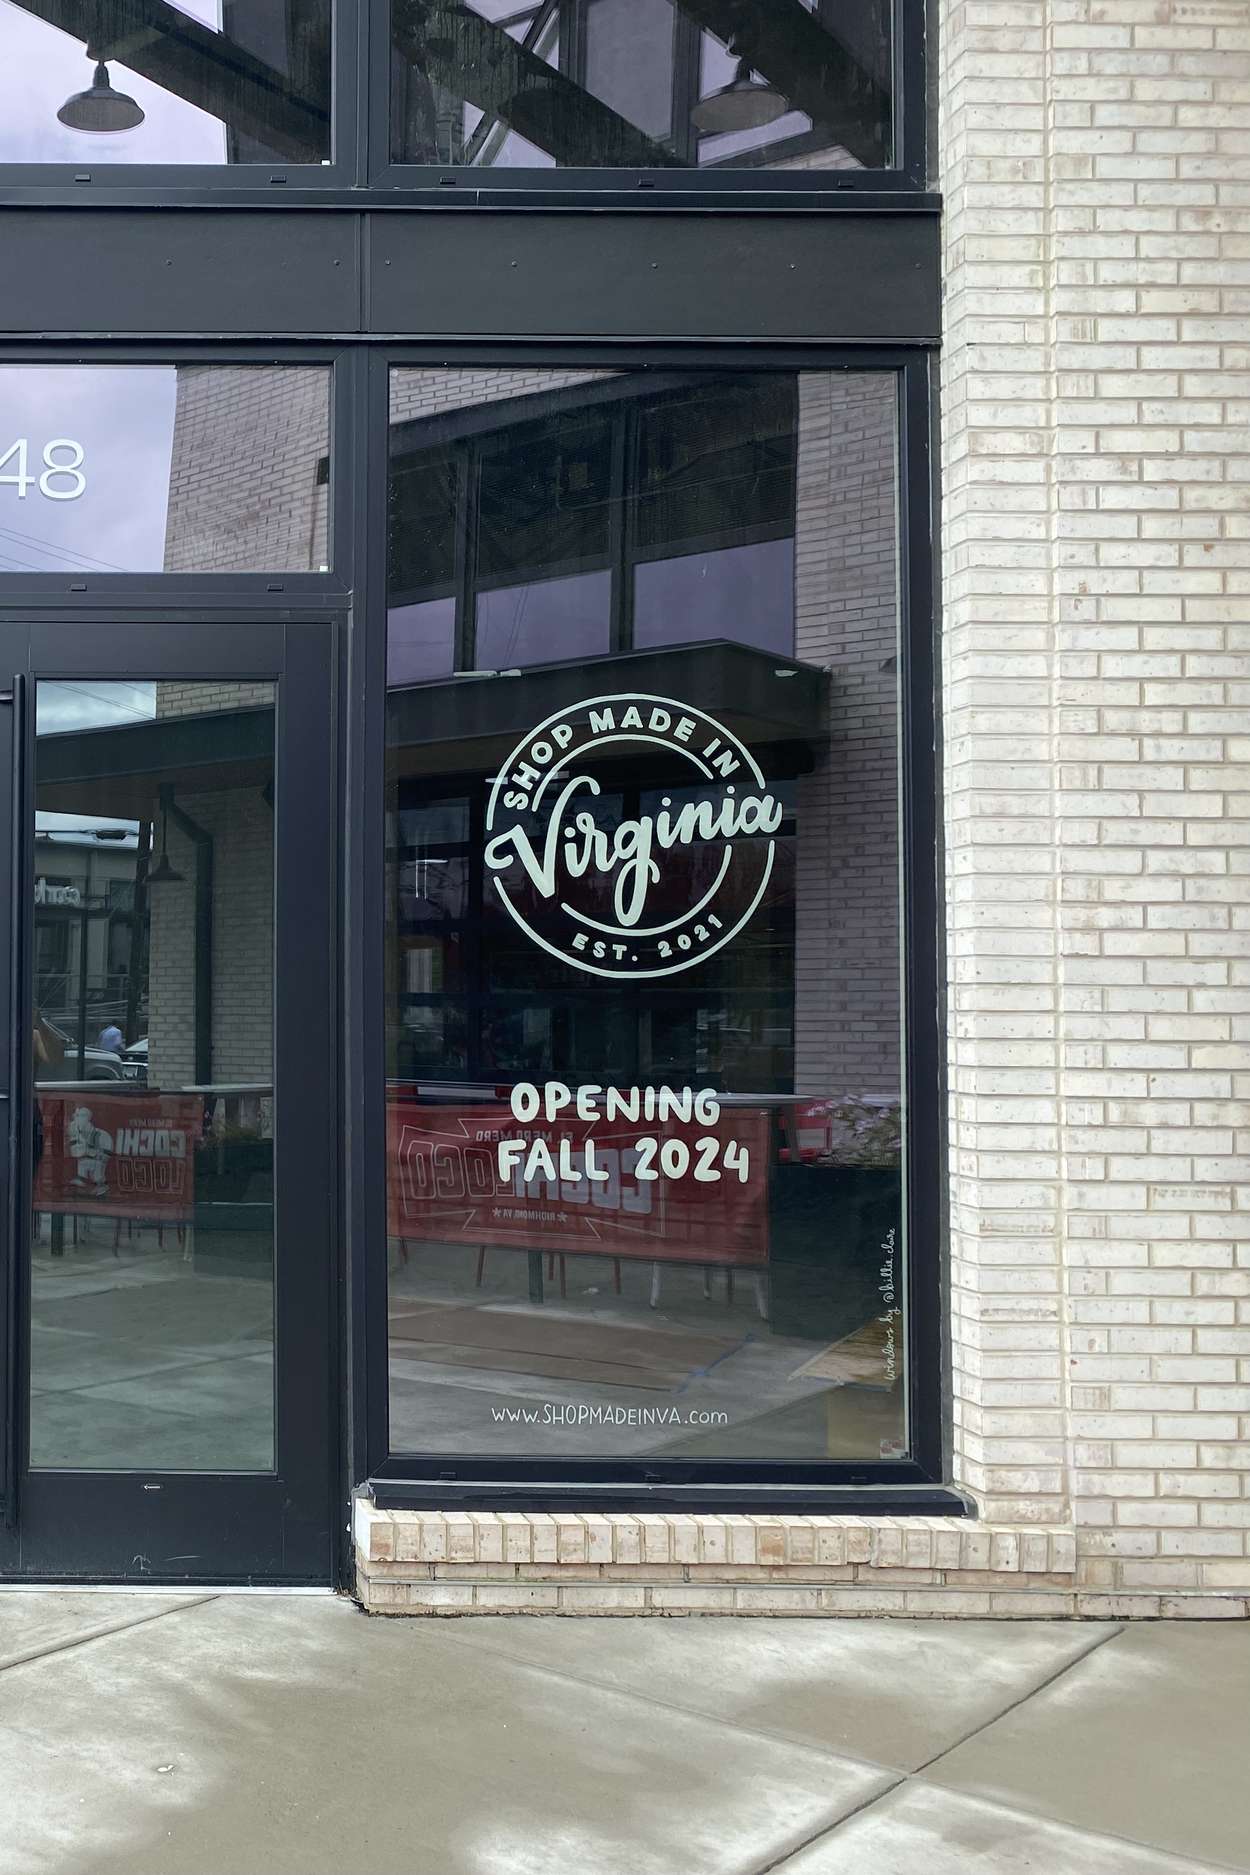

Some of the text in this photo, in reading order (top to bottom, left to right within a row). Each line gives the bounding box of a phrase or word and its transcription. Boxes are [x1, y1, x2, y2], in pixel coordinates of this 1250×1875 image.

[503, 706, 741, 810] SHOP MADE IN
[484, 775, 783, 927] Virginia
[572, 914, 723, 962] EST. 2021
[510, 1081, 721, 1127] OPENING
[497, 1137, 750, 1183] FALL 2024
[879, 1306, 900, 1324] by
[881, 1327, 896, 1381] windows
[491, 1404, 728, 1425] www.SHOPMADEINVA.com
